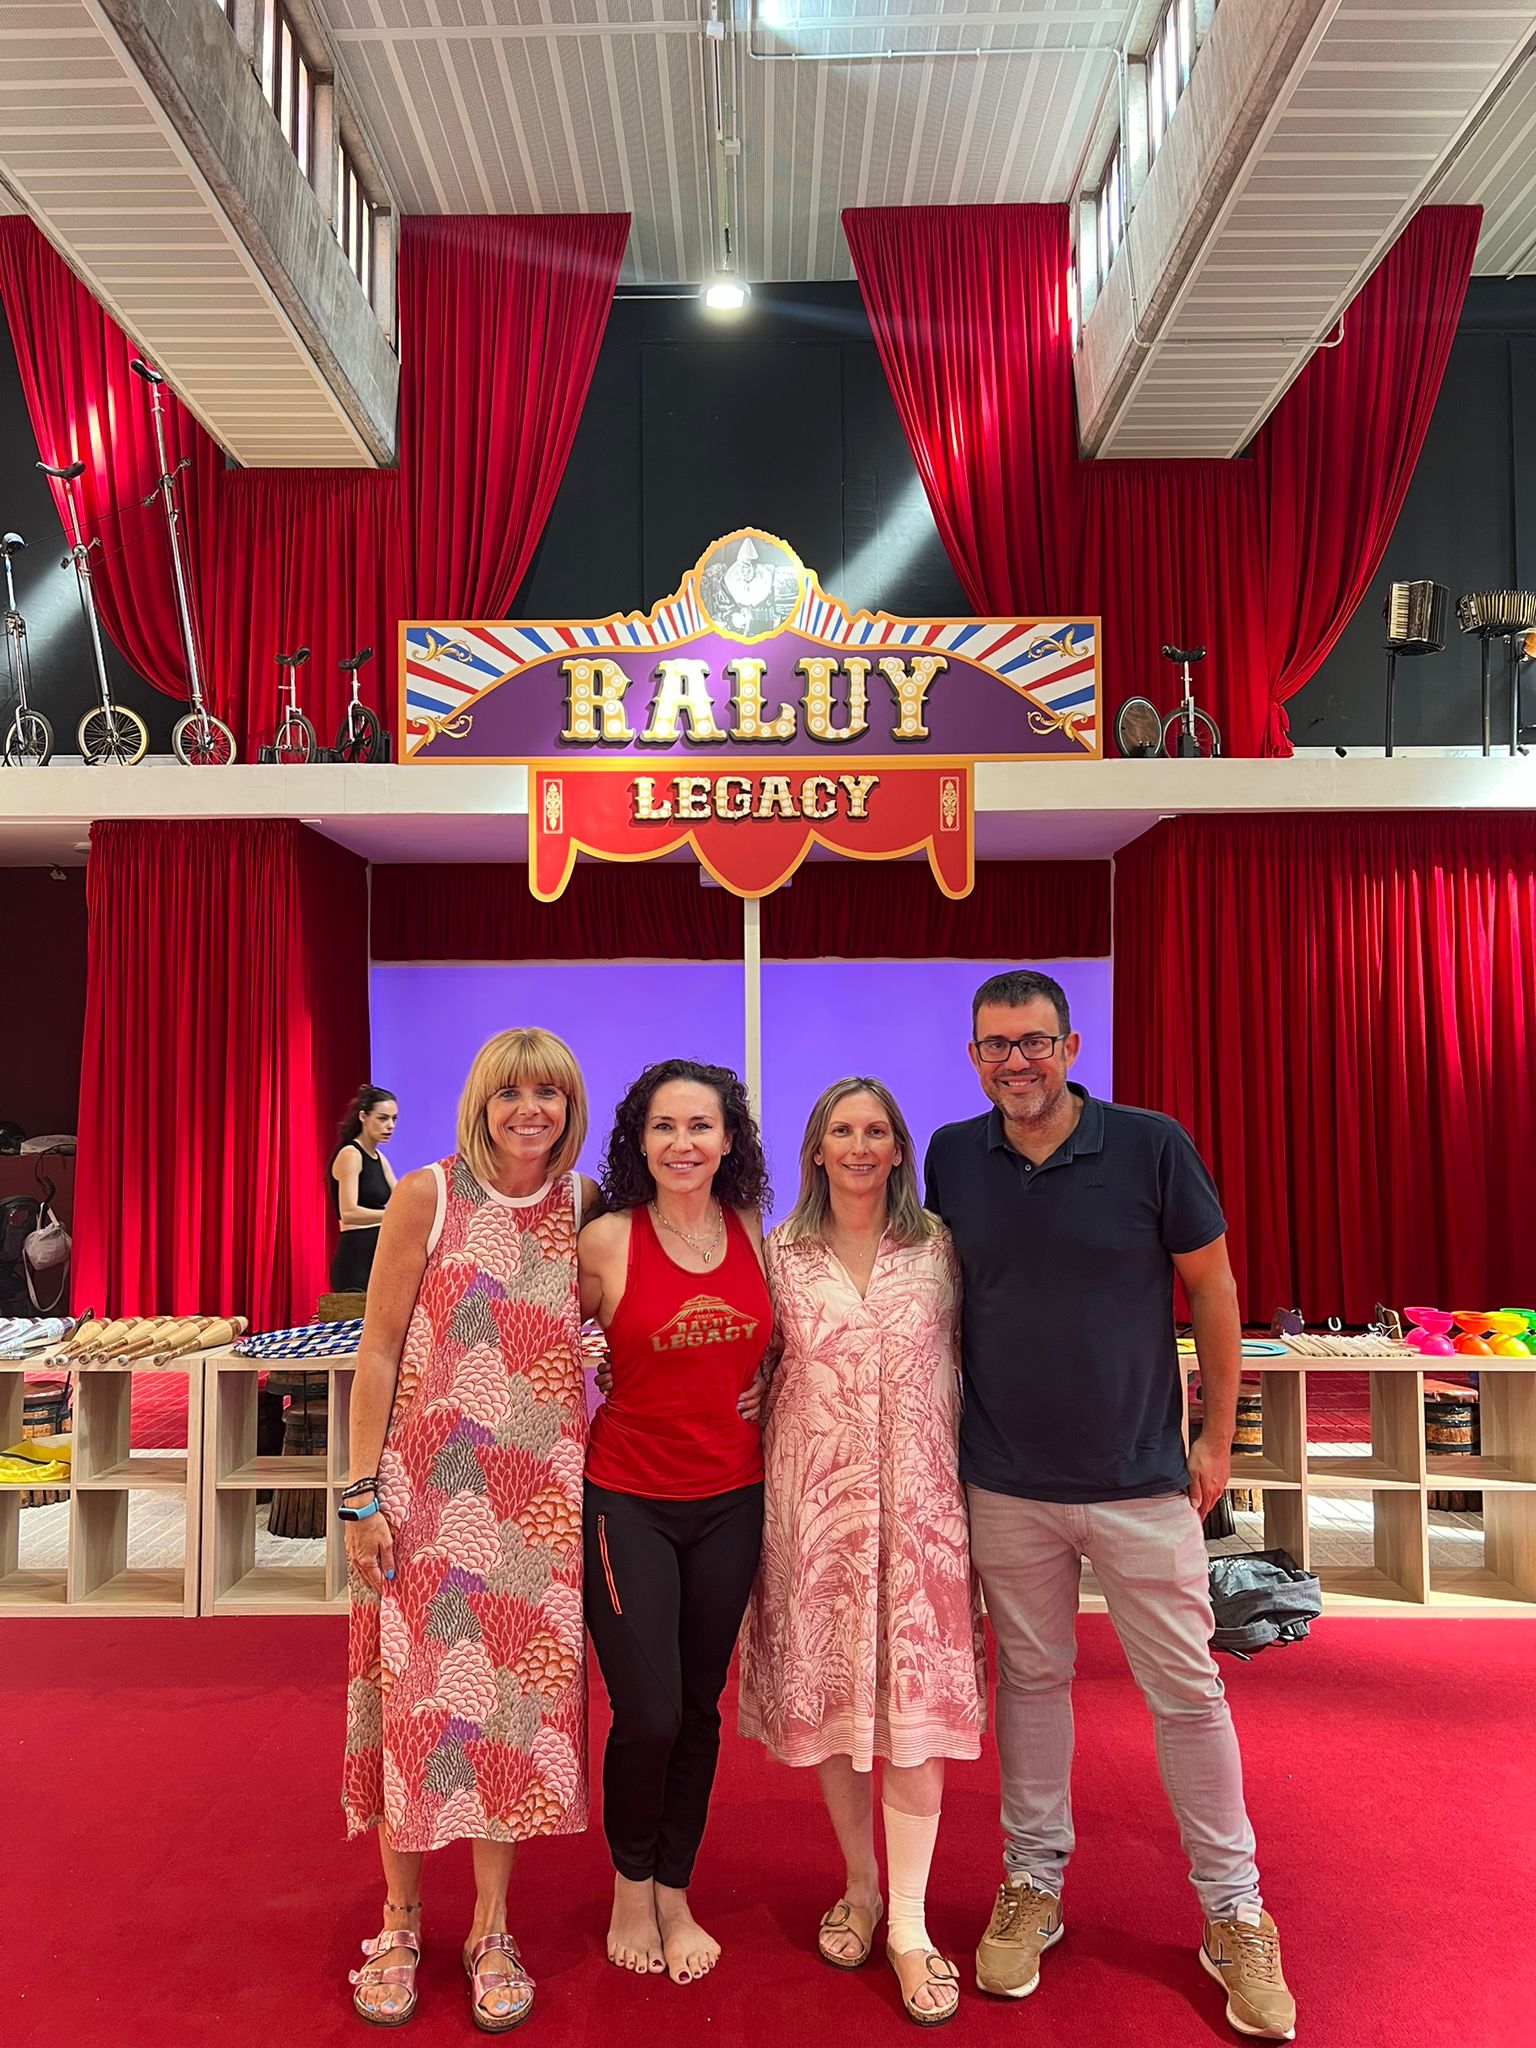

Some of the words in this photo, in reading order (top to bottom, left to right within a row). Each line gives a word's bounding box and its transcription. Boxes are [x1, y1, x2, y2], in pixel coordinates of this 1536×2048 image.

[561, 656, 950, 742] RALUY
[632, 775, 880, 821] LEGACY
[651, 1322, 758, 1352] LEGACY
[676, 1315, 734, 1332] RALUY
